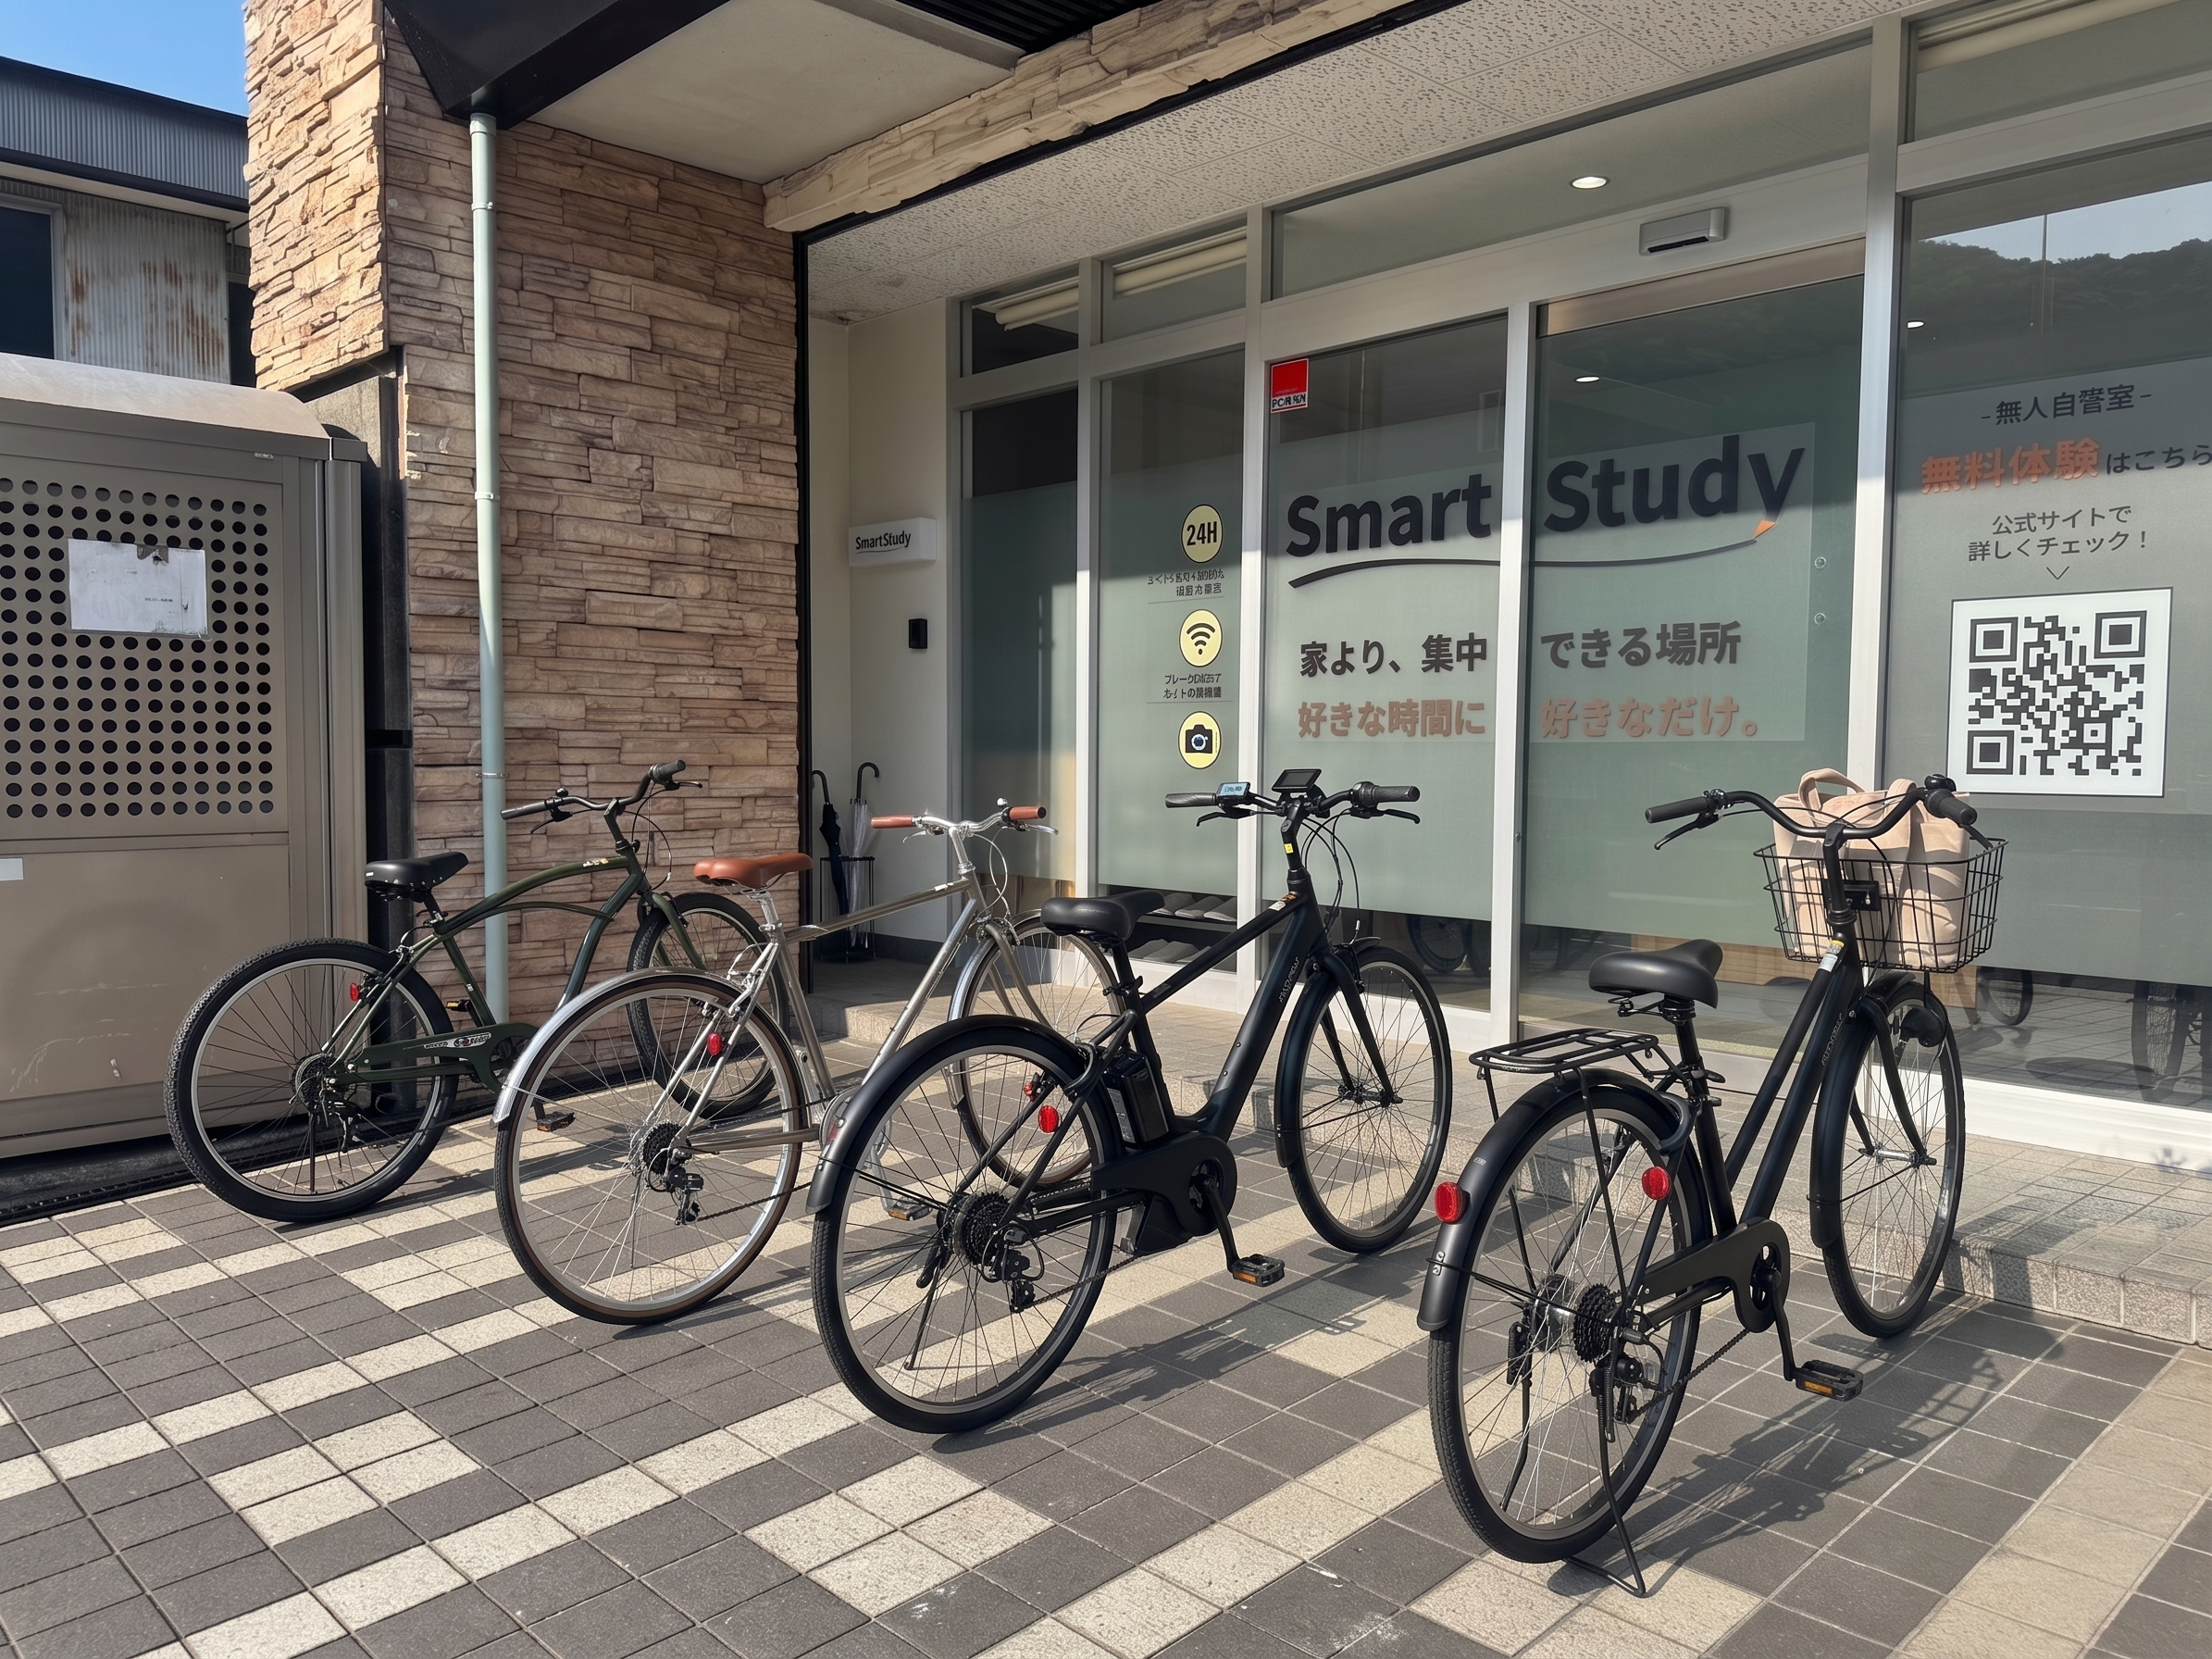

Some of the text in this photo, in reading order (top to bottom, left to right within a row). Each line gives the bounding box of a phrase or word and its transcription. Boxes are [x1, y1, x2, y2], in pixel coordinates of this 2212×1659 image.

[1286, 434, 1805, 557] Smart Study
[1187, 520, 1217, 546] 24H
[1992, 505, 2131, 535] 公式サイトで
[1540, 620, 1741, 668] できる場所
[1298, 696, 1758, 739] 好きな時間に 好きなだけ。
